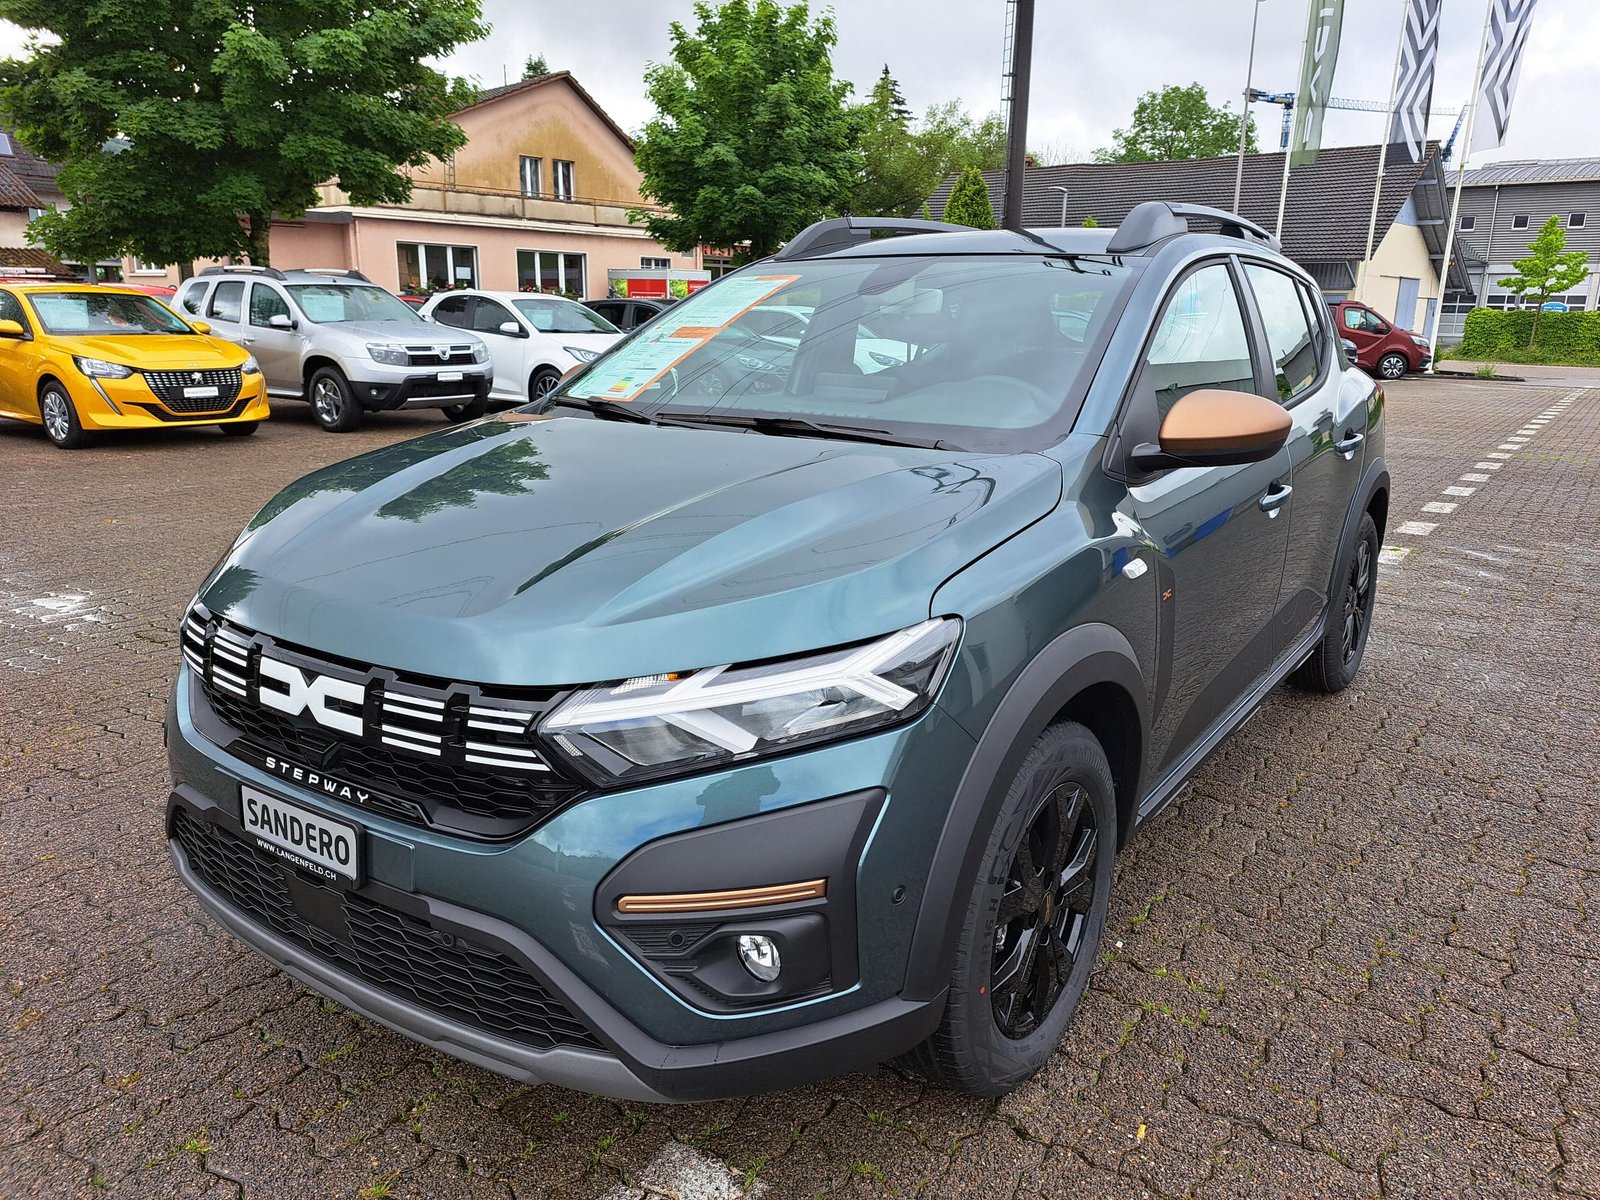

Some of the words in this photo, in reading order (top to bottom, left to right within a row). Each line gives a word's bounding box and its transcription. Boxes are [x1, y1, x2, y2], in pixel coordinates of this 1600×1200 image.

[1303, 0, 1336, 144] DACI
[266, 757, 368, 803] STEPWAY
[247, 798, 350, 866] SANDERO
[256, 838, 337, 881] WWW.LANGENFELD.CH
